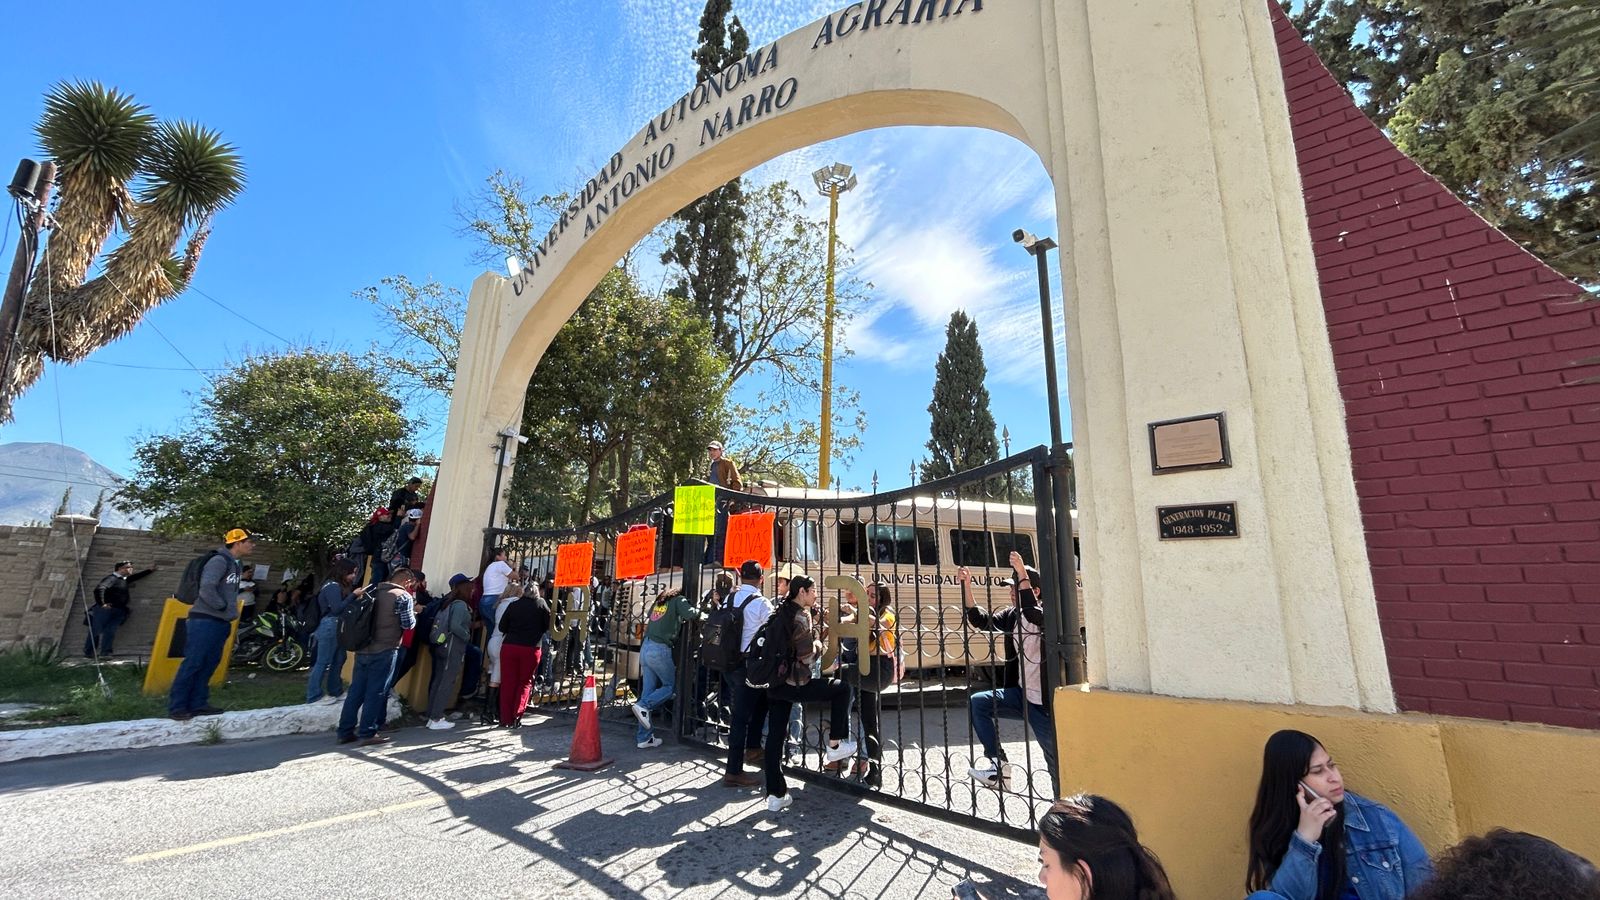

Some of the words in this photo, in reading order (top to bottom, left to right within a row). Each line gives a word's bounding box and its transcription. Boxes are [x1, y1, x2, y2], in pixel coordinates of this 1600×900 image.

[512, 152, 623, 296] UNIVERSIDAD
[643, 41, 778, 146] AUTONOMA
[584, 143, 675, 238] ANTONIO
[699, 77, 798, 146] NARRO
